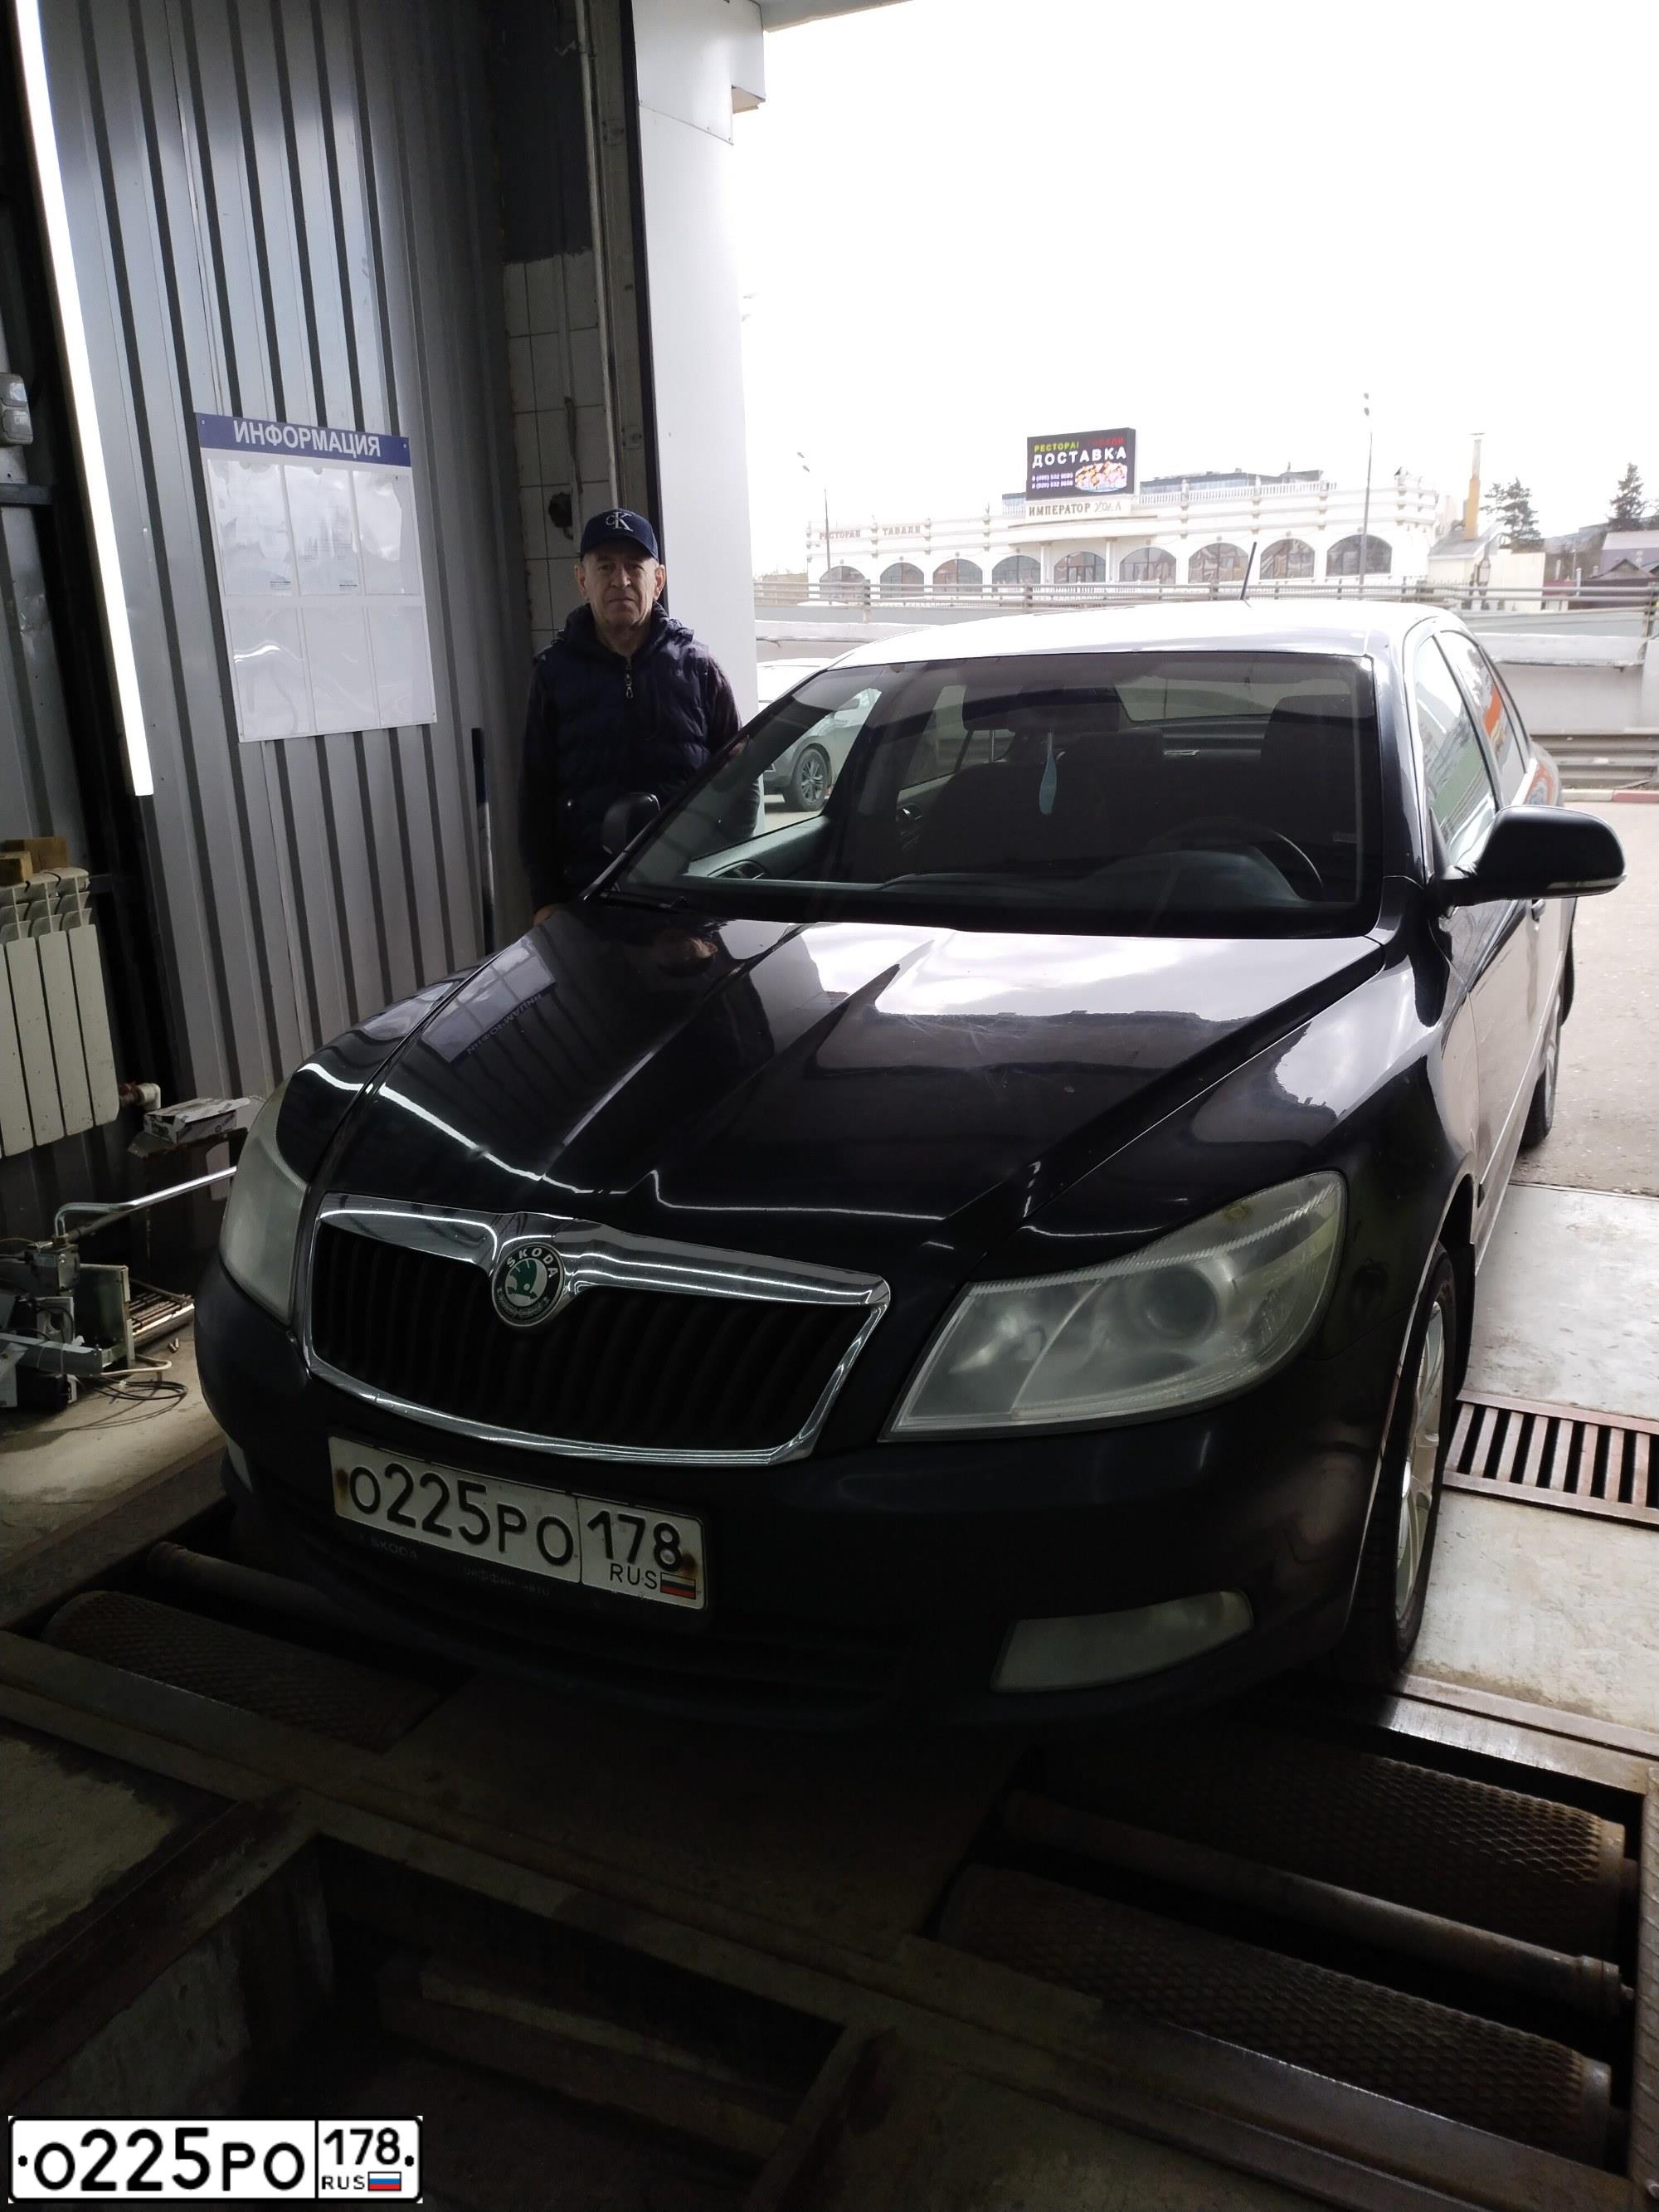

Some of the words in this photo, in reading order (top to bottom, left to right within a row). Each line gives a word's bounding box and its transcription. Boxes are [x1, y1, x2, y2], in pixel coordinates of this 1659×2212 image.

[233, 421, 381, 458] ИНФОРМАЦИЯ
[1032, 446, 1127, 469] ДОСТАВКА
[1029, 503, 1091, 517] ИМПЕРАТОР
[348, 1461, 575, 1566] О225РО
[586, 1510, 685, 1572] 178
[609, 1563, 658, 1591] RUS
